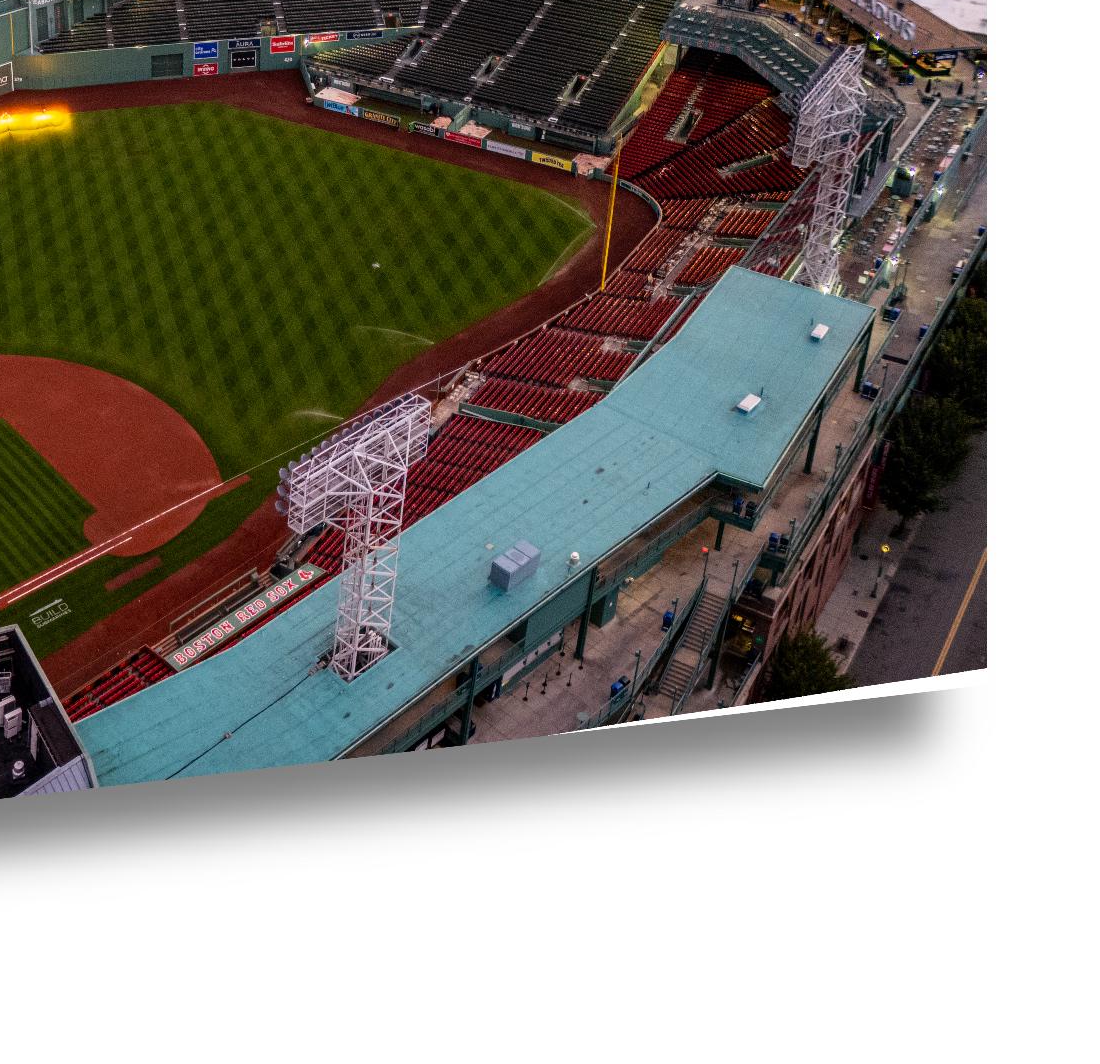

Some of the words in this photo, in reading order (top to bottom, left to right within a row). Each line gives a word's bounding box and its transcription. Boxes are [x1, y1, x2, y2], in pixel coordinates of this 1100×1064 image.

[414, 123, 436, 133] wasabi
[31, 603, 69, 625] BUILD
[173, 620, 236, 665] BOSTON
[235, 599, 267, 623] RED
[267, 578, 299, 603] SOX
